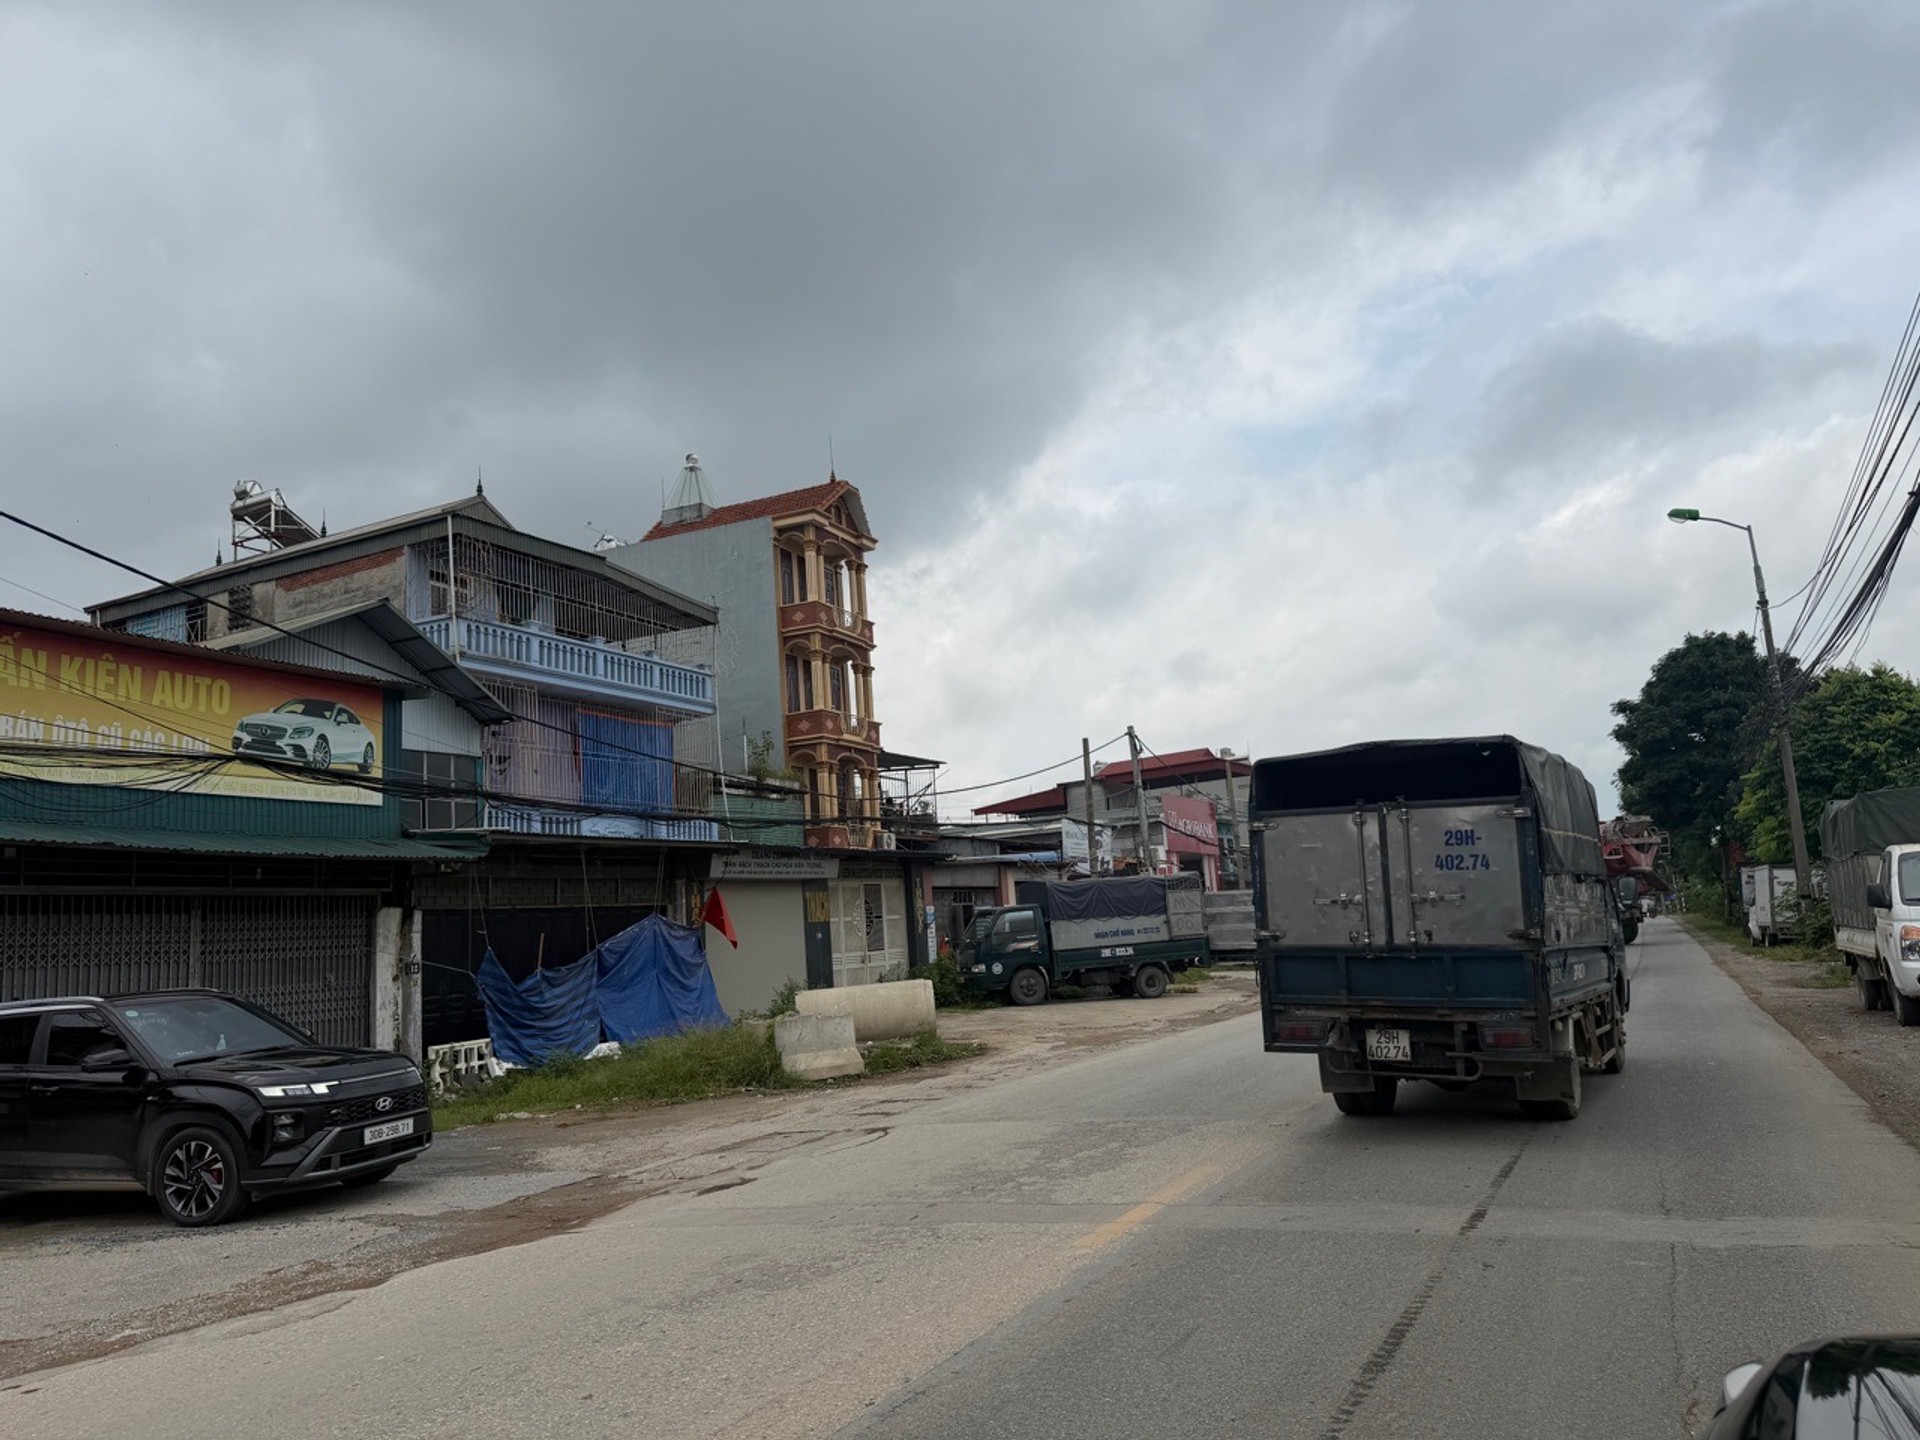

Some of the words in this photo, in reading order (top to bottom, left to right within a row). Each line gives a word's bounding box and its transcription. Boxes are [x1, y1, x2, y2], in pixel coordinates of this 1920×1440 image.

[59, 652, 143, 703] KIÊN
[151, 669, 232, 716] AUTO
[128, 725, 167, 752] CÁC
[1444, 829, 1482, 847] 29H-
[1434, 853, 1491, 871] 402.74
[1375, 1030, 1400, 1044] 29H
